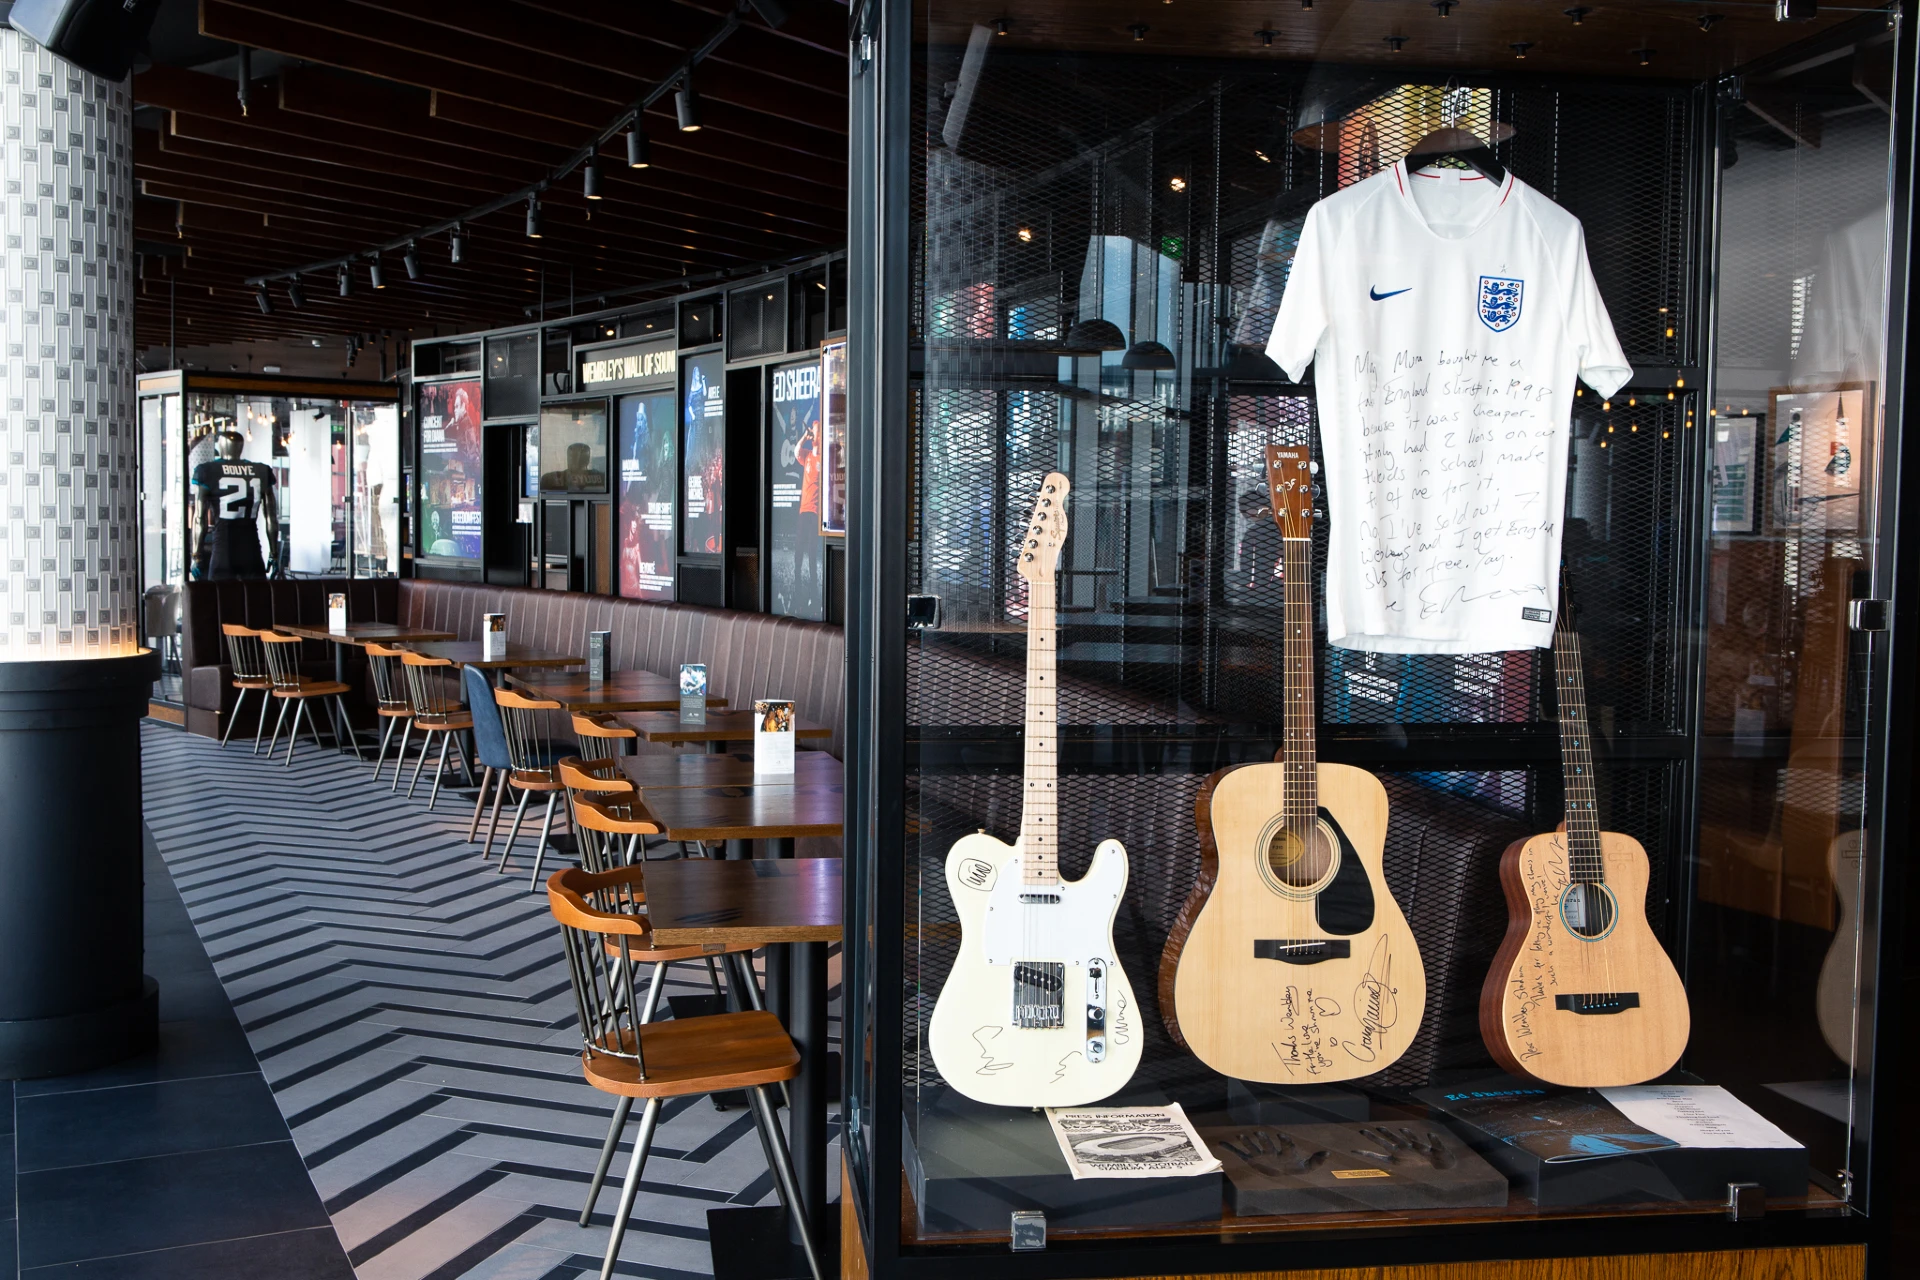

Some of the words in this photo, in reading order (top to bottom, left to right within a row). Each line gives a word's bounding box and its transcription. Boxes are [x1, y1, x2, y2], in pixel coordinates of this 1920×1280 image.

[583, 358, 623, 384] WEMBLEY'S
[624, 355, 643, 379] WALL
[645, 353, 653, 376] OF
[654, 350, 676, 375] SOUN
[1354, 351, 1378, 393] My
[1438, 348, 1477, 376] bought
[1482, 356, 1498, 366] me
[708, 386, 720, 399] ADELE
[773, 370, 785, 402] ED
[786, 366, 820, 401] SHEERA
[1384, 372, 1430, 413] England
[1406, 411, 1420, 431] it
[1427, 411, 1459, 426] was
[431, 429, 445, 442] DIANA
[1404, 431, 1429, 454] had
[1444, 432, 1456, 448] 2
[1505, 430, 1527, 440] on
[1277, 451, 1299, 459] YAMAHA
[1441, 449, 1484, 471] school
[1497, 445, 1544, 464] made
[222, 464, 255, 476] BOUYE
[218, 477, 261, 520] 21
[1386, 487, 1405, 510] of
[1442, 479, 1470, 506] for
[1380, 513, 1423, 539] I've
[1435, 502, 1469, 531] sold
[1473, 497, 1500, 518] out
[1419, 534, 1441, 552] and
[1454, 526, 1471, 549] I
[1473, 520, 1503, 554] get
[1398, 566, 1419, 589] for
[1548, 966, 1558, 986] such
[1280, 985, 1300, 1030] Wembley
[1511, 1001, 1535, 1038] Wembley
[1301, 1024, 1312, 1046] love
[1271, 1035, 1301, 1076] Thanks
[1302, 1047, 1315, 1062] the
[1519, 1041, 1543, 1062] Dear
[1444, 1093, 1470, 1101] Ed
[1471, 1089, 1546, 1098] Sheeran
